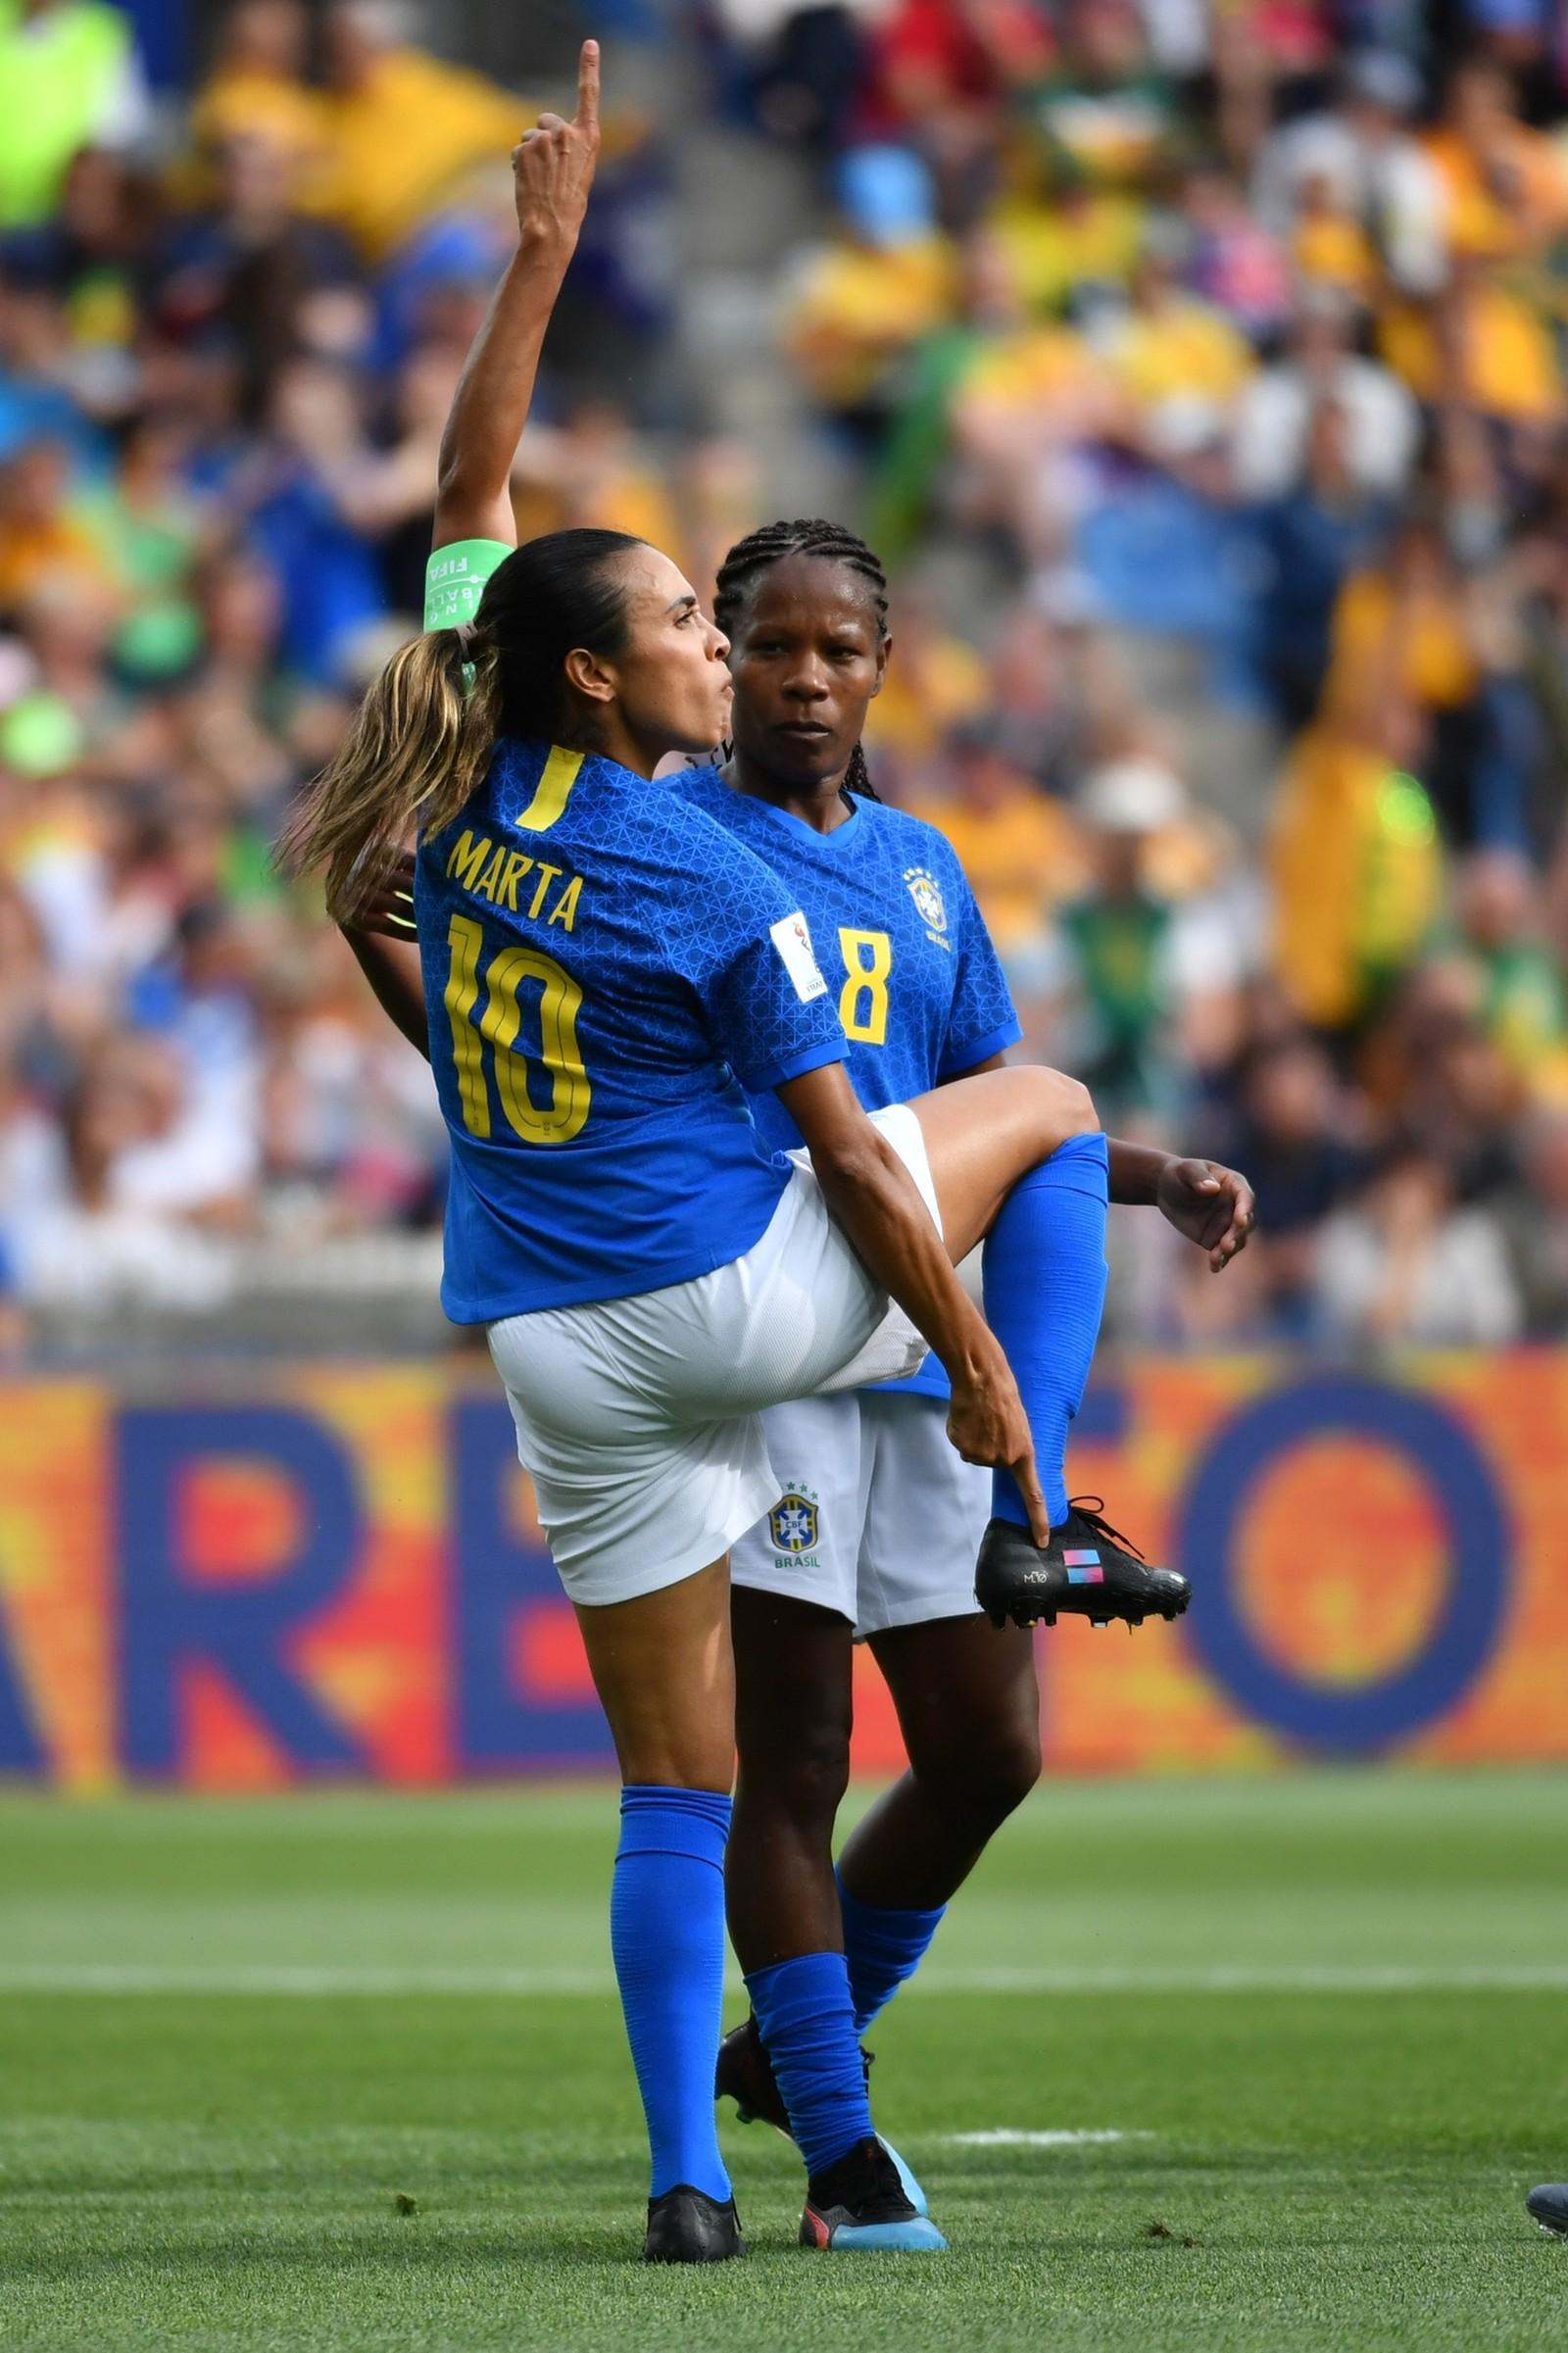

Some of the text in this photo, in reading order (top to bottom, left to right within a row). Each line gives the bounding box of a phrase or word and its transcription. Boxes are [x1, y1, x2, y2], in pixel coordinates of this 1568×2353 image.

[430, 557, 467, 581] FIFA
[429, 587, 484, 611] BALL
[431, 600, 475, 625] ING
[446, 829, 584, 932] MARTA
[838, 927, 891, 1046] 8
[444, 913, 591, 1143] 10
[785, 1520, 803, 1529] CBF
[774, 1555, 821, 1569] BRASIL
